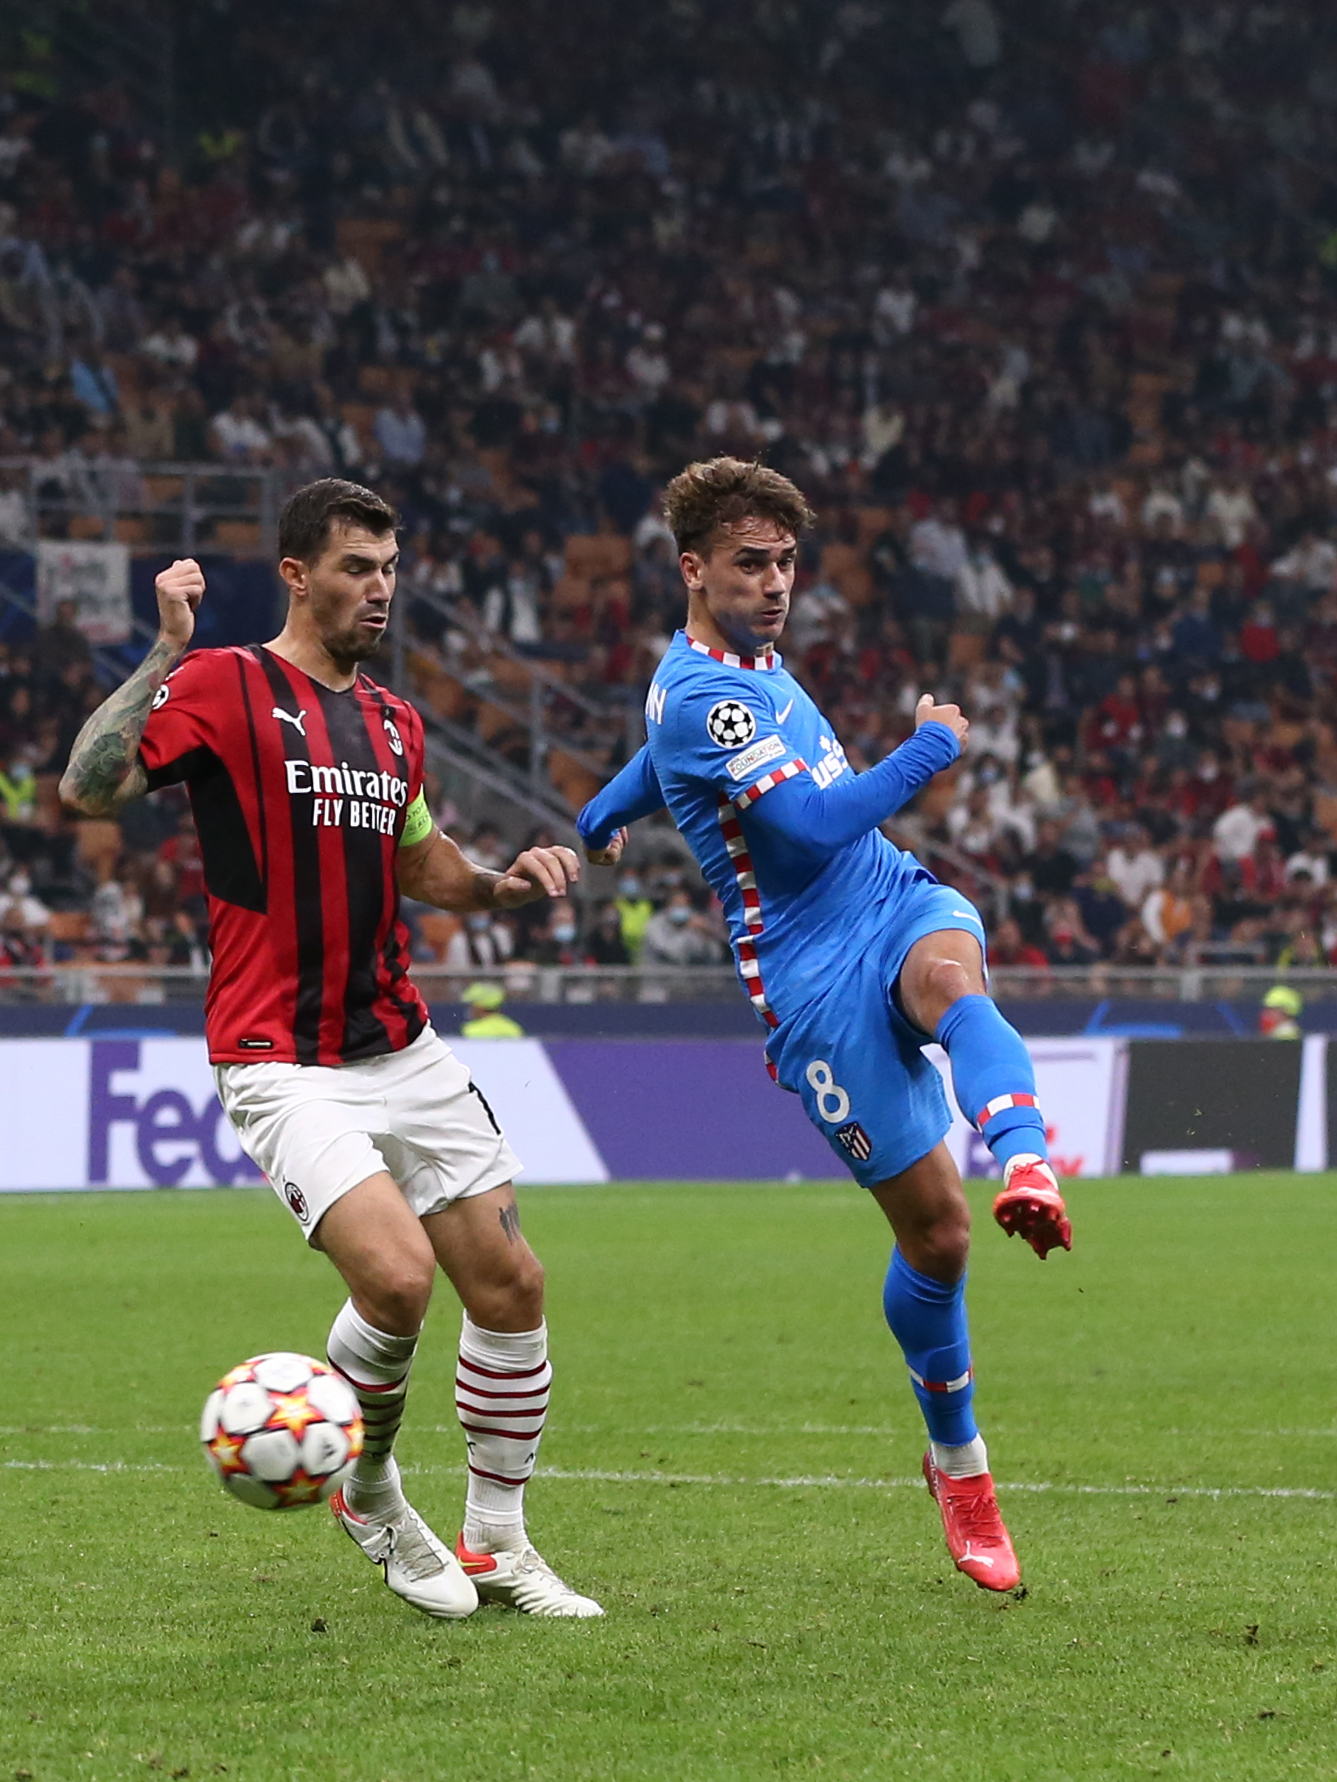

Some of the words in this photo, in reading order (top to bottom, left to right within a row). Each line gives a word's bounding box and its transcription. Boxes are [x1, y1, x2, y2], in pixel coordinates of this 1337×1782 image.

[284, 760, 408, 807] Emirates
[312, 798, 344, 827] FLY
[350, 800, 397, 837] BETTER
[806, 1059, 850, 1124] 8
